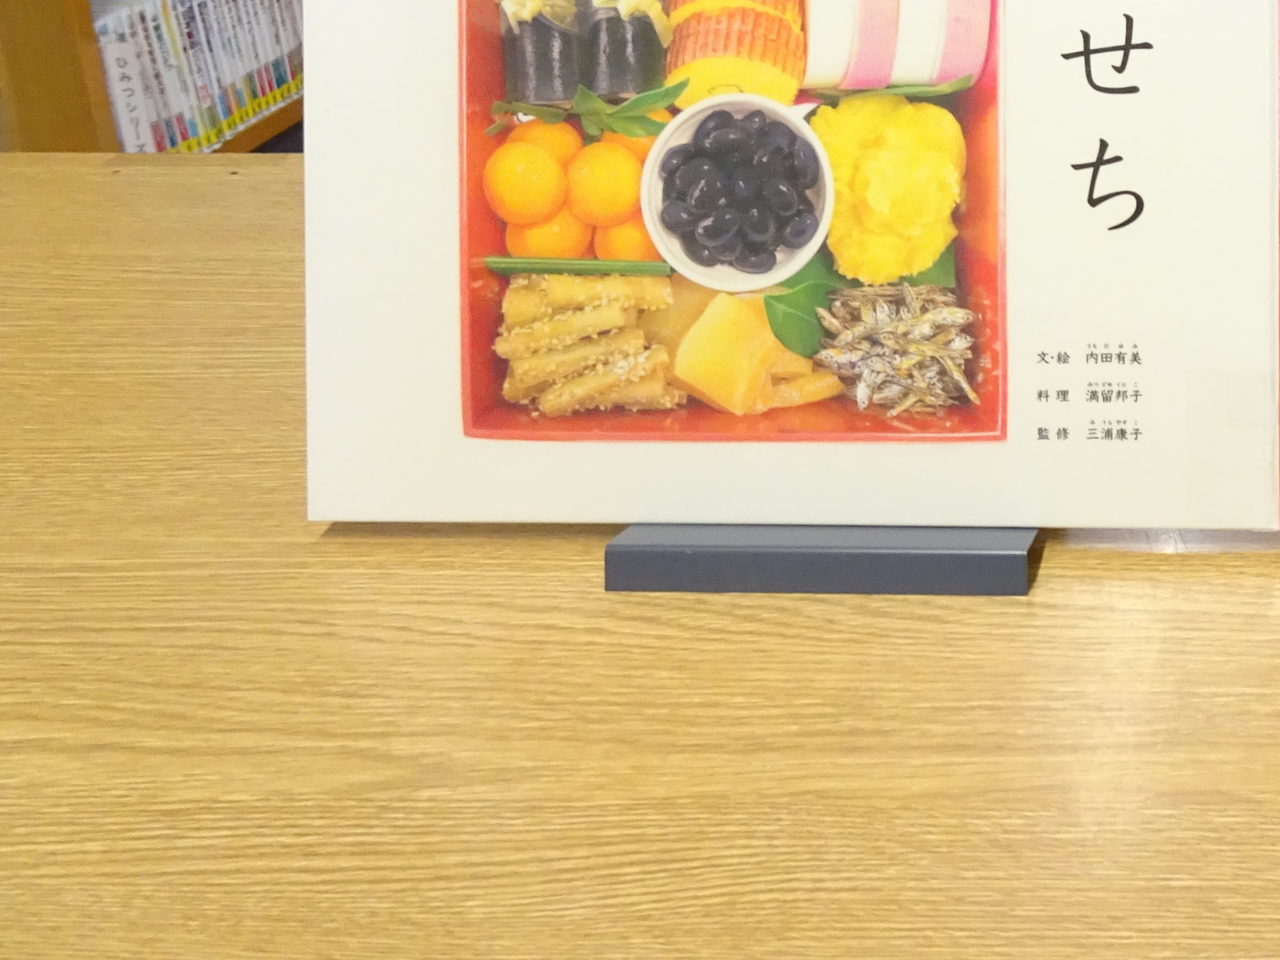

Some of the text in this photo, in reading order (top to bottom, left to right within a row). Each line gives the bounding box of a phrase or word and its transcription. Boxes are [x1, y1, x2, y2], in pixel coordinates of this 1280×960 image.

[1086, 351, 1142, 365] 内田有美
[1086, 390, 1143, 403] 満留邦子
[1037, 427, 1143, 441] 監修 三浦康子
